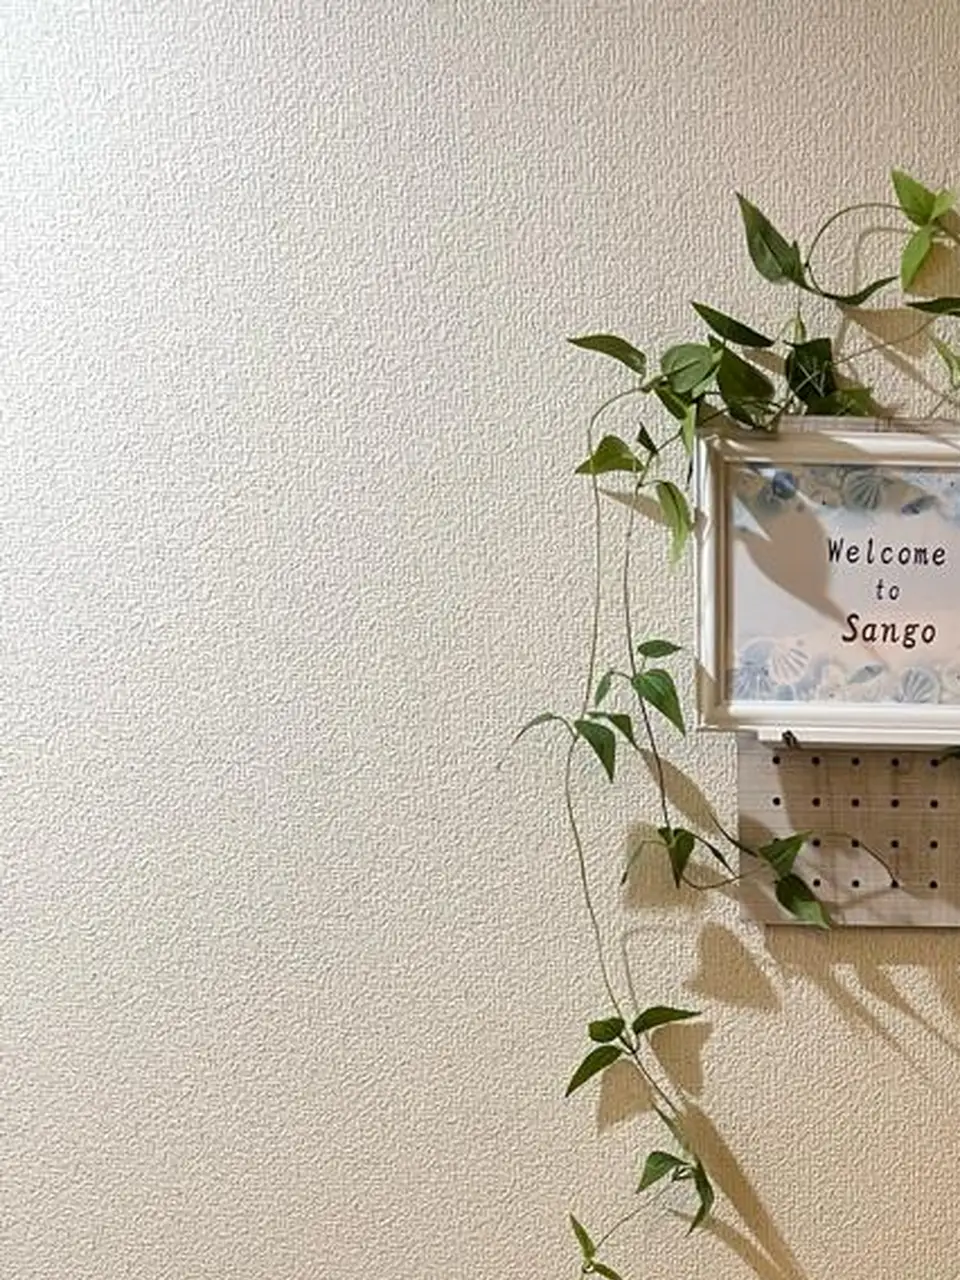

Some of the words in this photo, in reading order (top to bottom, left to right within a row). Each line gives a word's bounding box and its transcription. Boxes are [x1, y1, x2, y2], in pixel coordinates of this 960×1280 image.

[827, 537, 946, 566] Welcome
[876, 578, 901, 600] to
[841, 613, 937, 649] Sango
